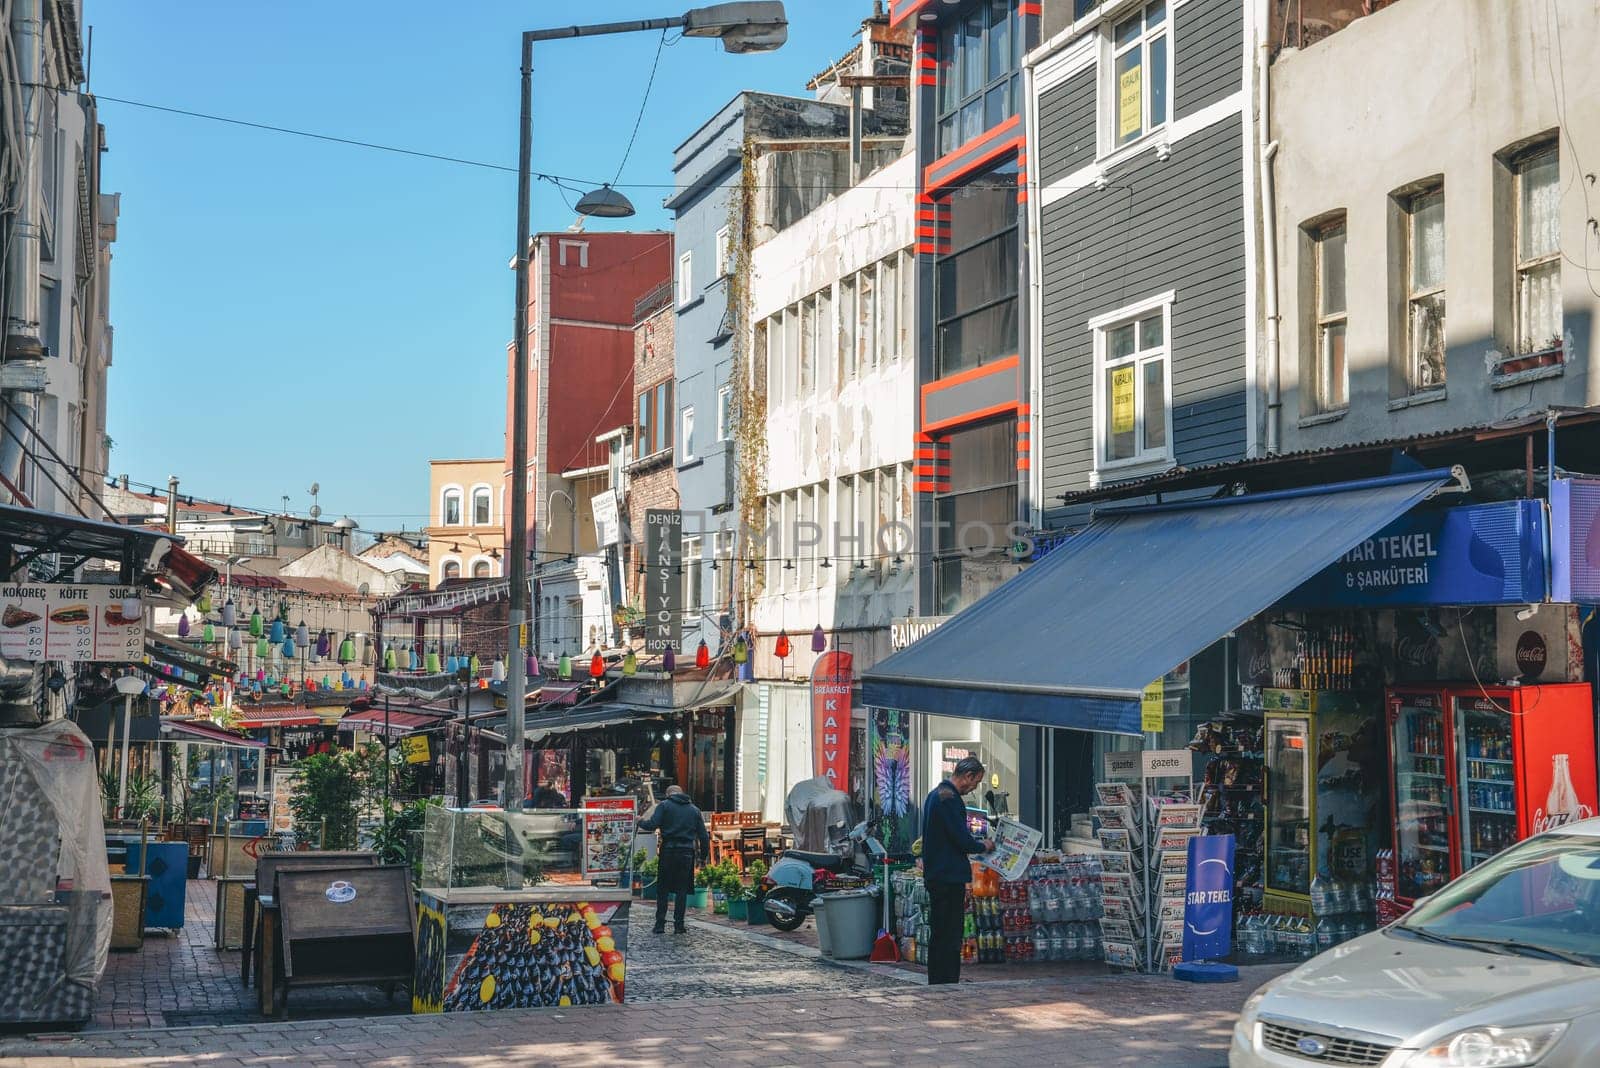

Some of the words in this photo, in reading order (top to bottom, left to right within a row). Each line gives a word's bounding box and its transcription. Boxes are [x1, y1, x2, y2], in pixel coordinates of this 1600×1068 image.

[649, 513, 680, 525] DENİZ
[1379, 533, 1437, 559] TEKEL
[1357, 562, 1428, 591] ŞARKÜTERİ
[2, 586, 46, 600] KOKOREÇ
[60, 586, 88, 599] KÖFTE
[109, 588, 142, 599] SUCK
[29, 626, 41, 634] 50
[76, 626, 91, 634] 50
[127, 627, 140, 635] 50
[29, 637, 42, 646] 60
[77, 638, 91, 647] 60
[126, 638, 140, 647] 60
[648, 639, 680, 649] HOSTEL
[76, 650, 91, 659] 70
[126, 650, 140, 660] 70
[1111, 760, 1134, 771] gazete
[1151, 758, 1180, 769] gazete
[1187, 891, 1206, 905] STAR
[1208, 889, 1231, 904] TEKEL
